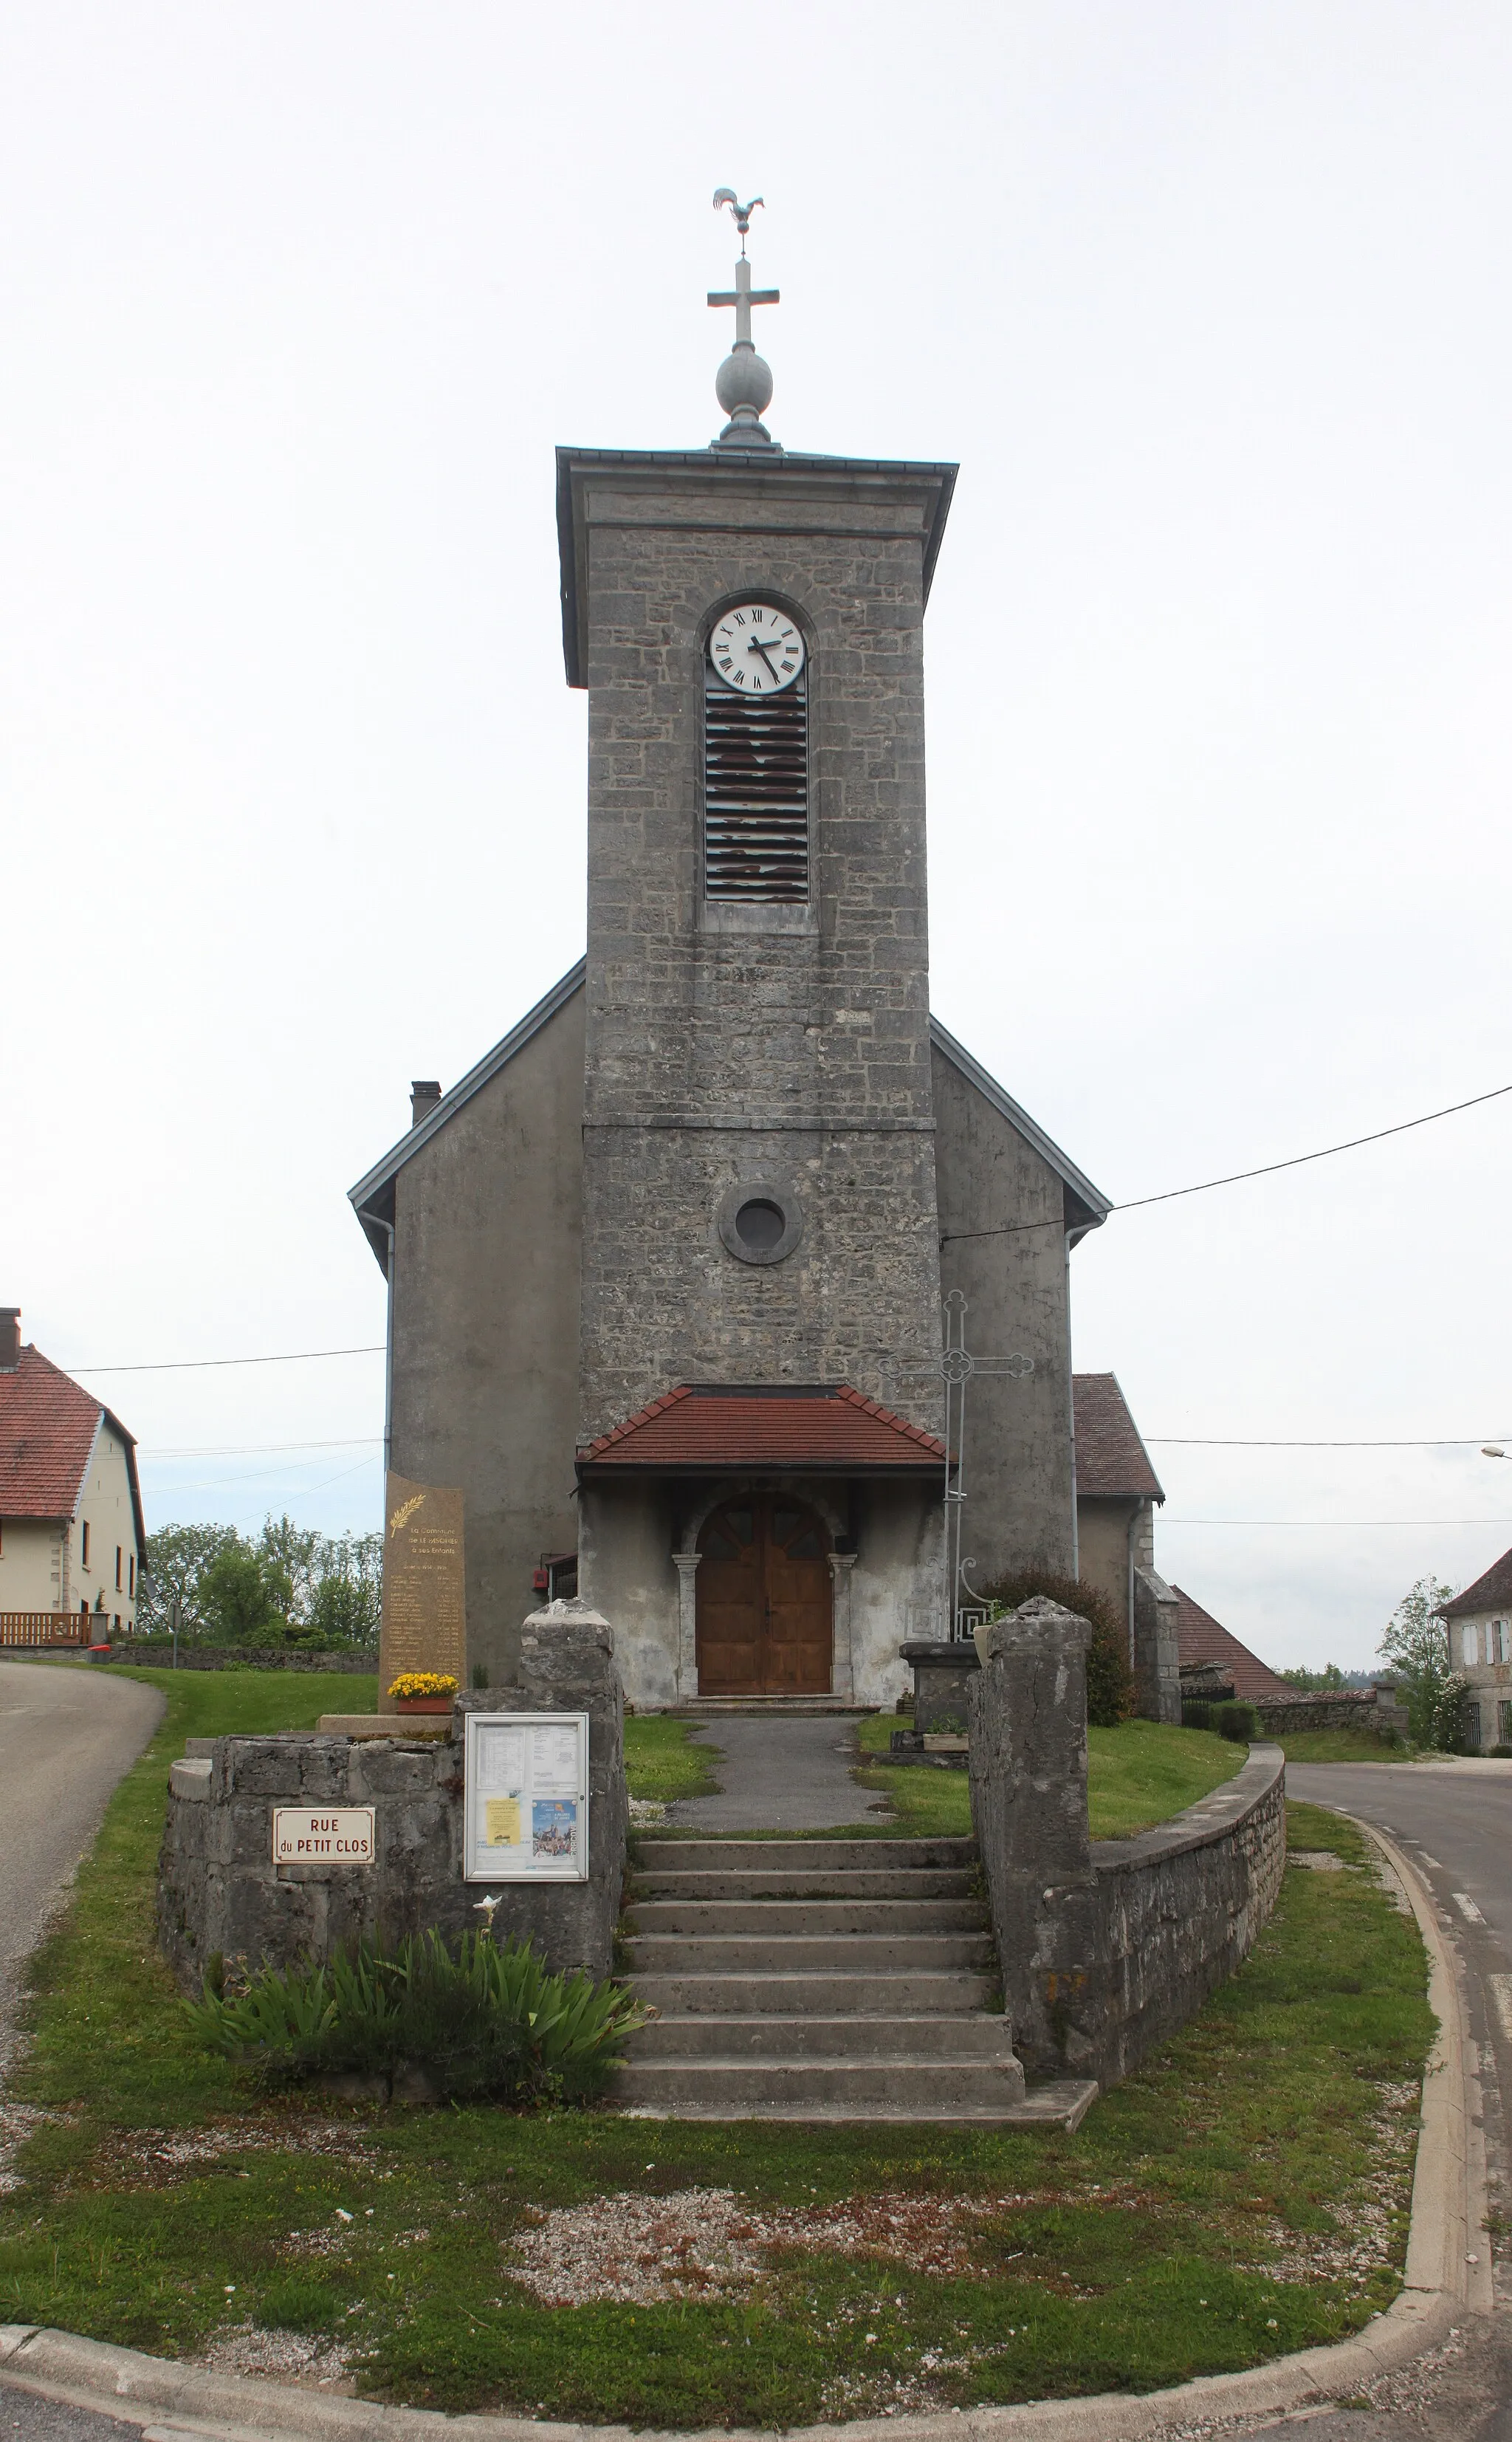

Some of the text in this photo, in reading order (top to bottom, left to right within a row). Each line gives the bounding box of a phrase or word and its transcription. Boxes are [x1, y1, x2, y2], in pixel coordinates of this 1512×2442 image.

[733, 613, 745, 626] XI
[752, 609, 762, 622] XII
[721, 626, 733, 637] X
[781, 629, 793, 638] II
[719, 657, 733, 672] VIII
[733, 670, 745, 685] VII
[754, 676, 762, 689] VI
[311, 1819, 339, 1831] RUE
[281, 1839, 368, 1852] du PETIT CLOS
